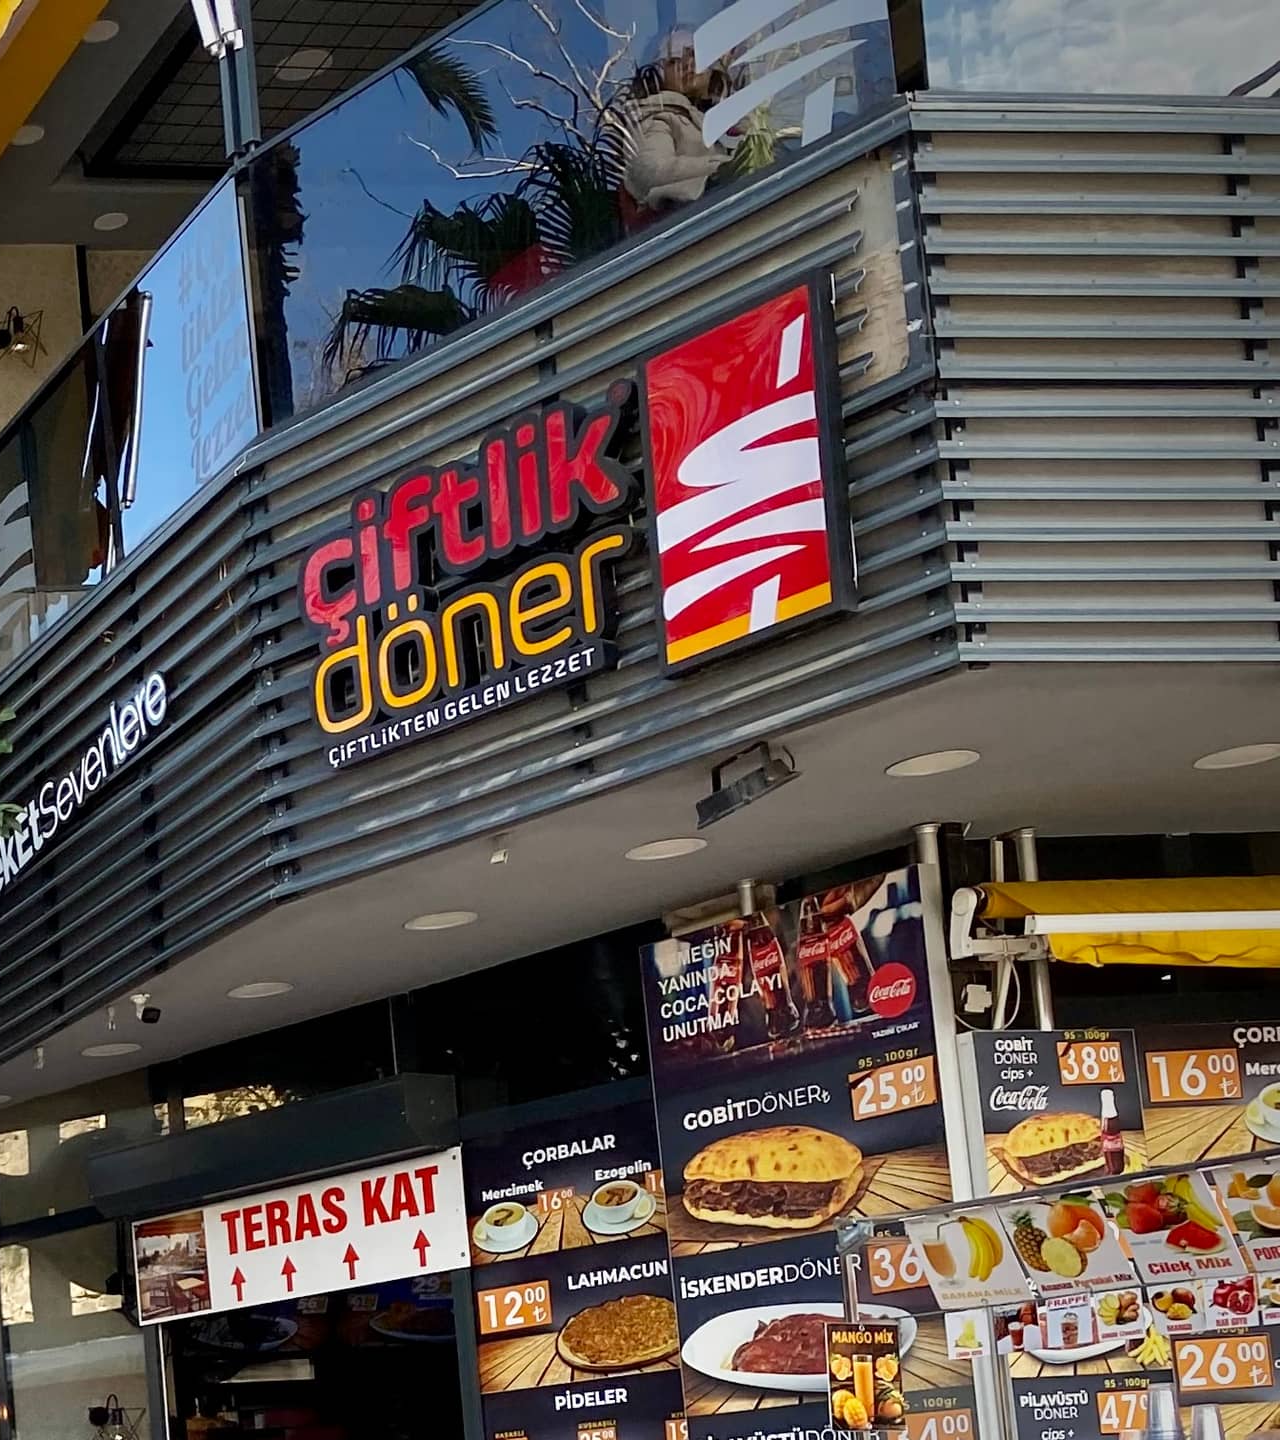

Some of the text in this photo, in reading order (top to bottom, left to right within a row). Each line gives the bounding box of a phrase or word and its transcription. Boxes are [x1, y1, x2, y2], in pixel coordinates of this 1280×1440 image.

[304, 410, 620, 646] çiftlik
[315, 534, 624, 735] döner
[444, 680, 510, 721] GELEN
[515, 648, 595, 693] LEZZET
[858, 1048, 919, 1068] 95 100gr
[522, 1134, 617, 1170] ÇORBALAR
[594, 1160, 653, 1181] Ezogelin
[482, 1180, 545, 1202] Mercimek
[647, 1173, 664, 1193] 1
[221, 1165, 439, 1255] TERAS KAT
[1197, 1256, 1233, 1270] Mix
[567, 1260, 669, 1290] LAHMACUN
[832, 1330, 871, 1345] MANGO
[555, 1388, 628, 1411] PİDELER
[1020, 1390, 1089, 1408] PİLAVÜSTÜ
